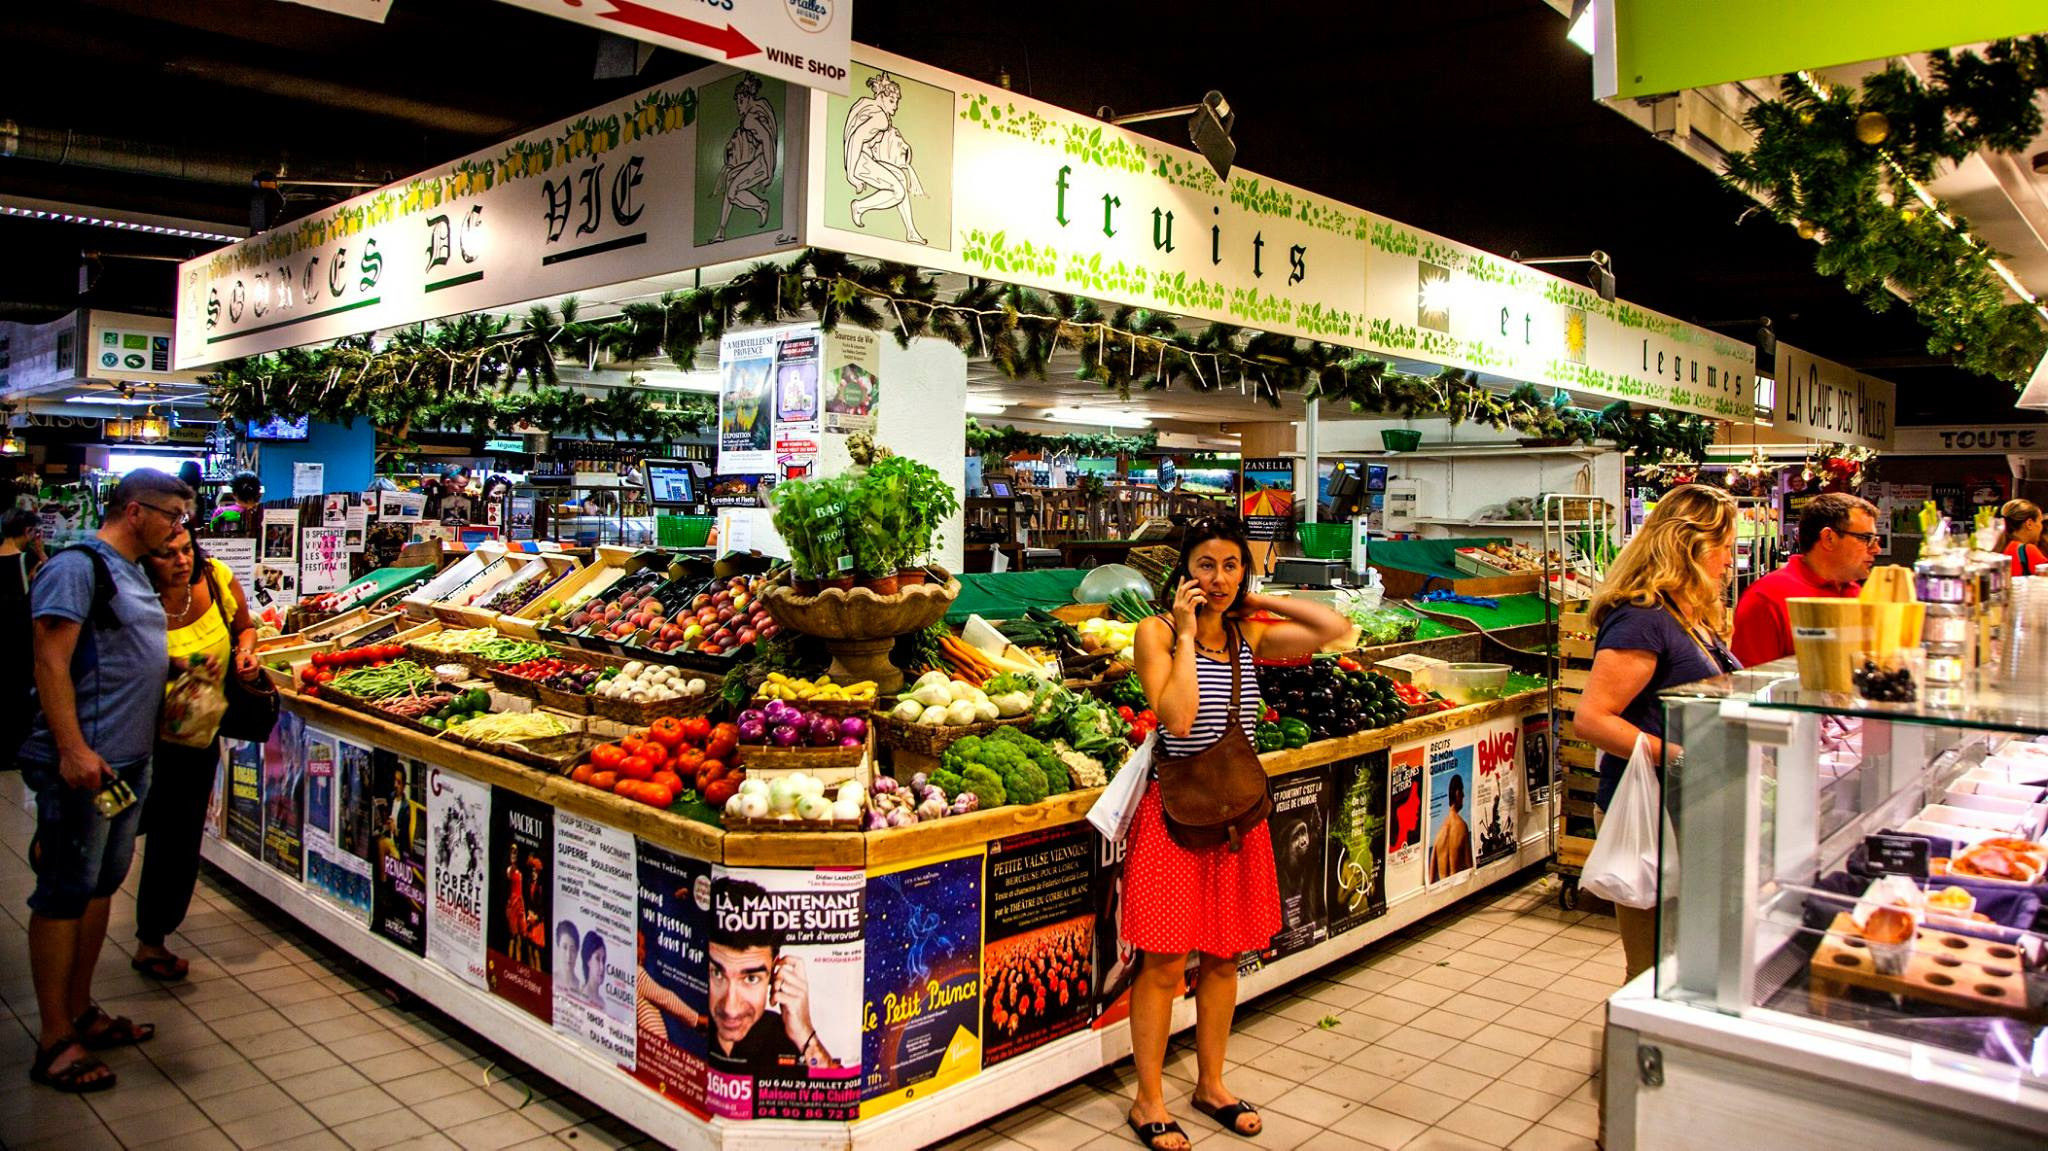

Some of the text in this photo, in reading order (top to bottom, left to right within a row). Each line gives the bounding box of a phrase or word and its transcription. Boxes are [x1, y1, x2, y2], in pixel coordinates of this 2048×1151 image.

[766, 47, 846, 81] WINE SHOP
[542, 155, 646, 246] VIE
[1056, 165, 1307, 287] fruits
[835, 331, 856, 342] Sources
[733, 346, 764, 356] PROVENCE
[1501, 306, 1743, 397] et legumes
[1808, 363, 1832, 429] CAVE
[1837, 388, 1853, 434] DES
[1858, 379, 1887, 441] HALLES
[1939, 430, 2037, 449] TOUTE
[1245, 461, 1292, 471] ZANELLA
[306, 529, 345, 538] 9 SPECTACLE
[305, 551, 320, 560] LES
[305, 563, 337, 571] FESTIVAL
[1438, 749, 1454, 761] MON
[1478, 728, 1519, 777] BANG!
[1430, 759, 1458, 776] QUARTIER
[558, 843, 588, 862] SUPERBE
[993, 841, 1089, 877] PETITE VALSE VIENNOISE
[1101, 837, 1127, 868] De
[385, 855, 413, 885] RENAUD
[816, 873, 864, 881] Didier LANDUCCI
[1005, 861, 1080, 887] BERCEUSE POUR LORCA
[435, 866, 481, 900] ROBERT
[436, 881, 481, 921] LE DIABLE
[716, 891, 860, 913] LÀ, MAINTENANT
[657, 911, 693, 939] poisson
[716, 907, 860, 932] TOUT DE SUITE
[657, 931, 704, 964] dans l'air
[786, 929, 861, 943] ou l'art d'improviser
[606, 963, 635, 988] CAMILLE
[605, 982, 634, 1006] CLAUDEL
[862, 1001, 878, 1032] Le
[884, 991, 922, 1025] Petit
[927, 980, 977, 1011] Prince
[707, 1071, 752, 1100] 16h05
[758, 1088, 796, 1100] Maison
[812, 1089, 825, 1101] de
[759, 1079, 772, 1088] DU
[774, 1079, 779, 1088] 6
[782, 1079, 793, 1088] AU
[795, 1080, 806, 1089] 29
[808, 1080, 842, 1089] JUILLET
[844, 1078, 862, 1089] 2018
[758, 1107, 778, 1117] 04
[782, 1108, 800, 1118] 90
[805, 1109, 824, 1118] 86
[828, 1109, 844, 1118] 72
